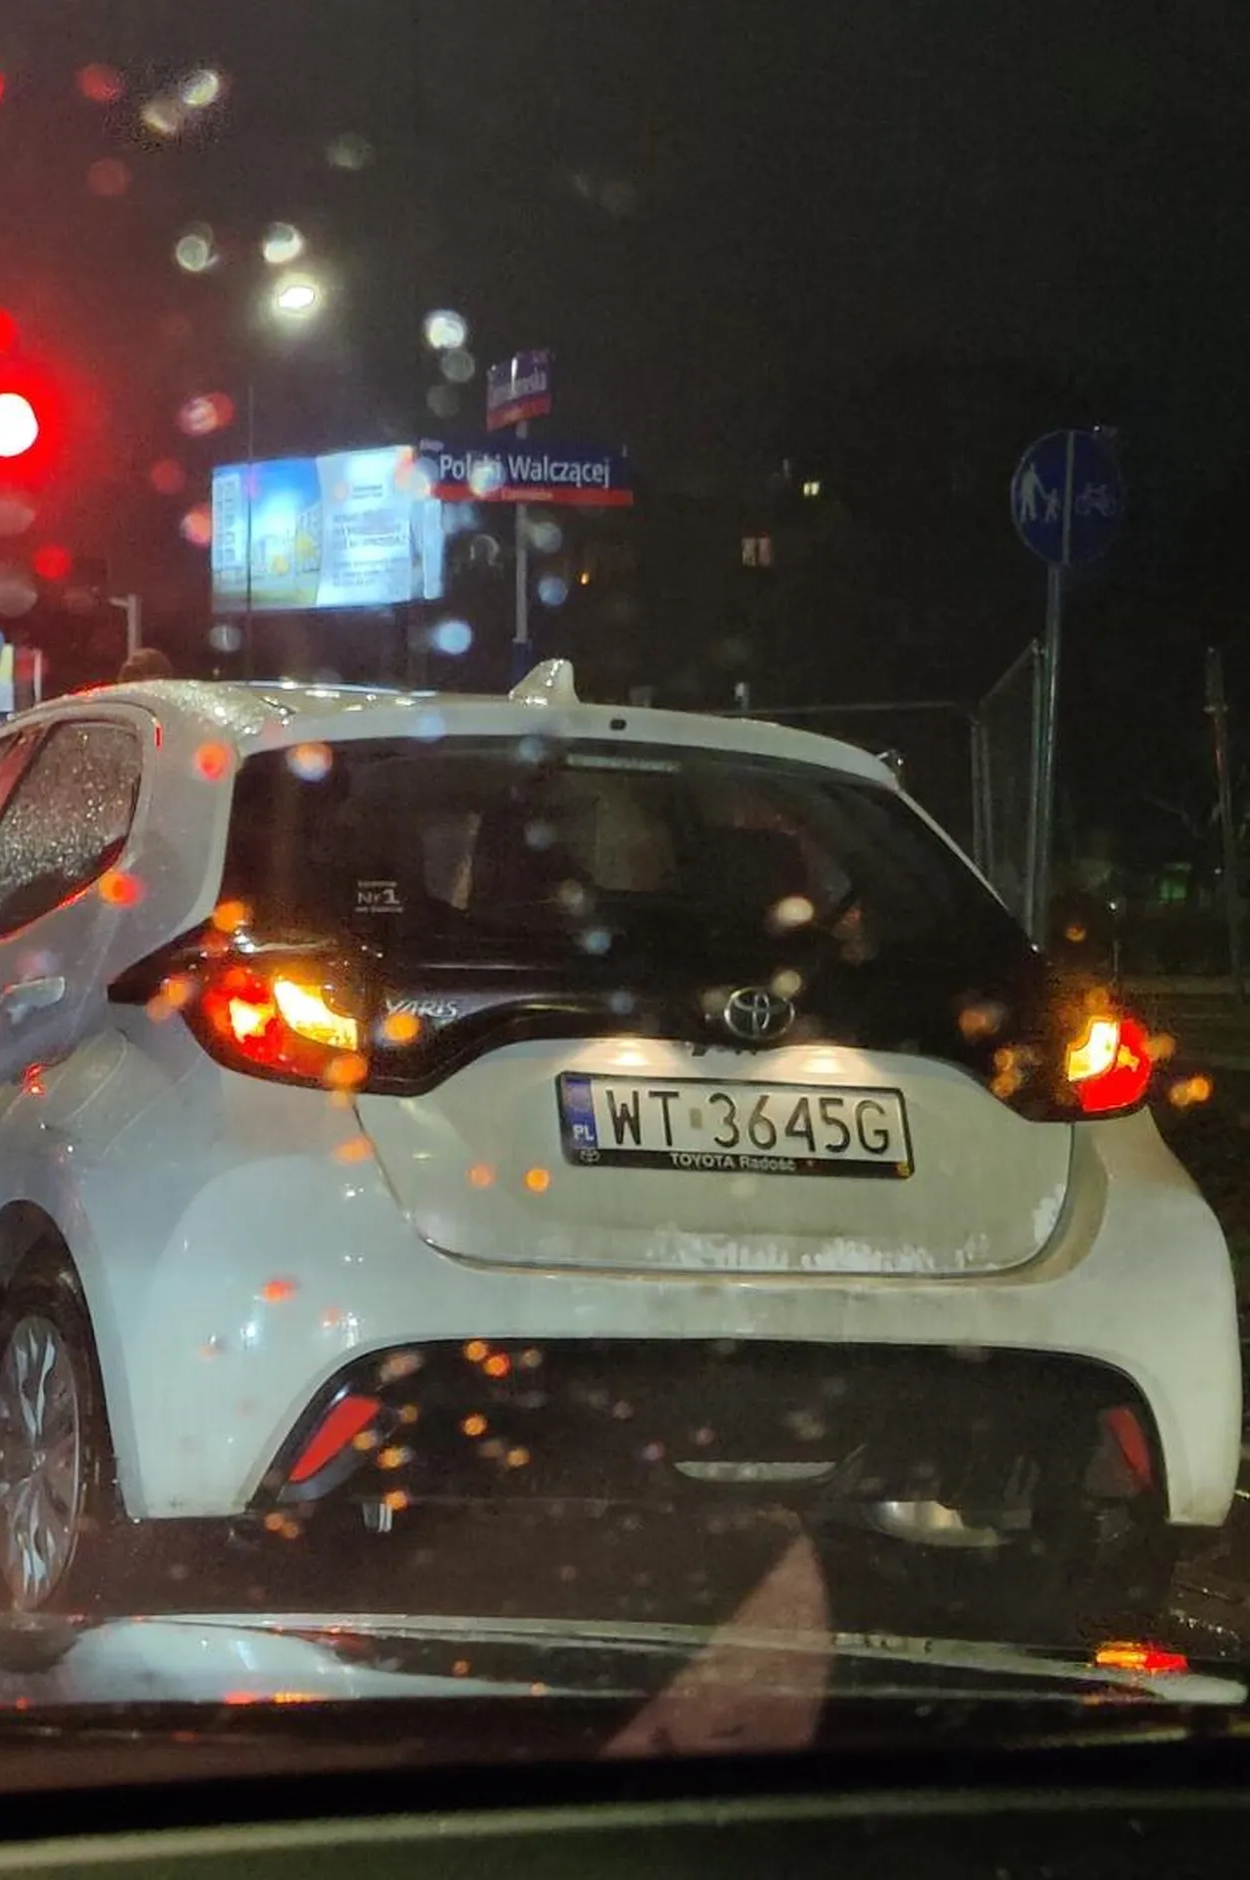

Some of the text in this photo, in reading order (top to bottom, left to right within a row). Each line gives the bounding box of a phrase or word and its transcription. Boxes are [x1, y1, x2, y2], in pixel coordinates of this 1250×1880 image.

[507, 453, 610, 488] Walczącej
[572, 1123, 595, 1142] PL
[605, 1088, 890, 1155] WT 3645G
[669, 1152, 734, 1169] TOYOTA
